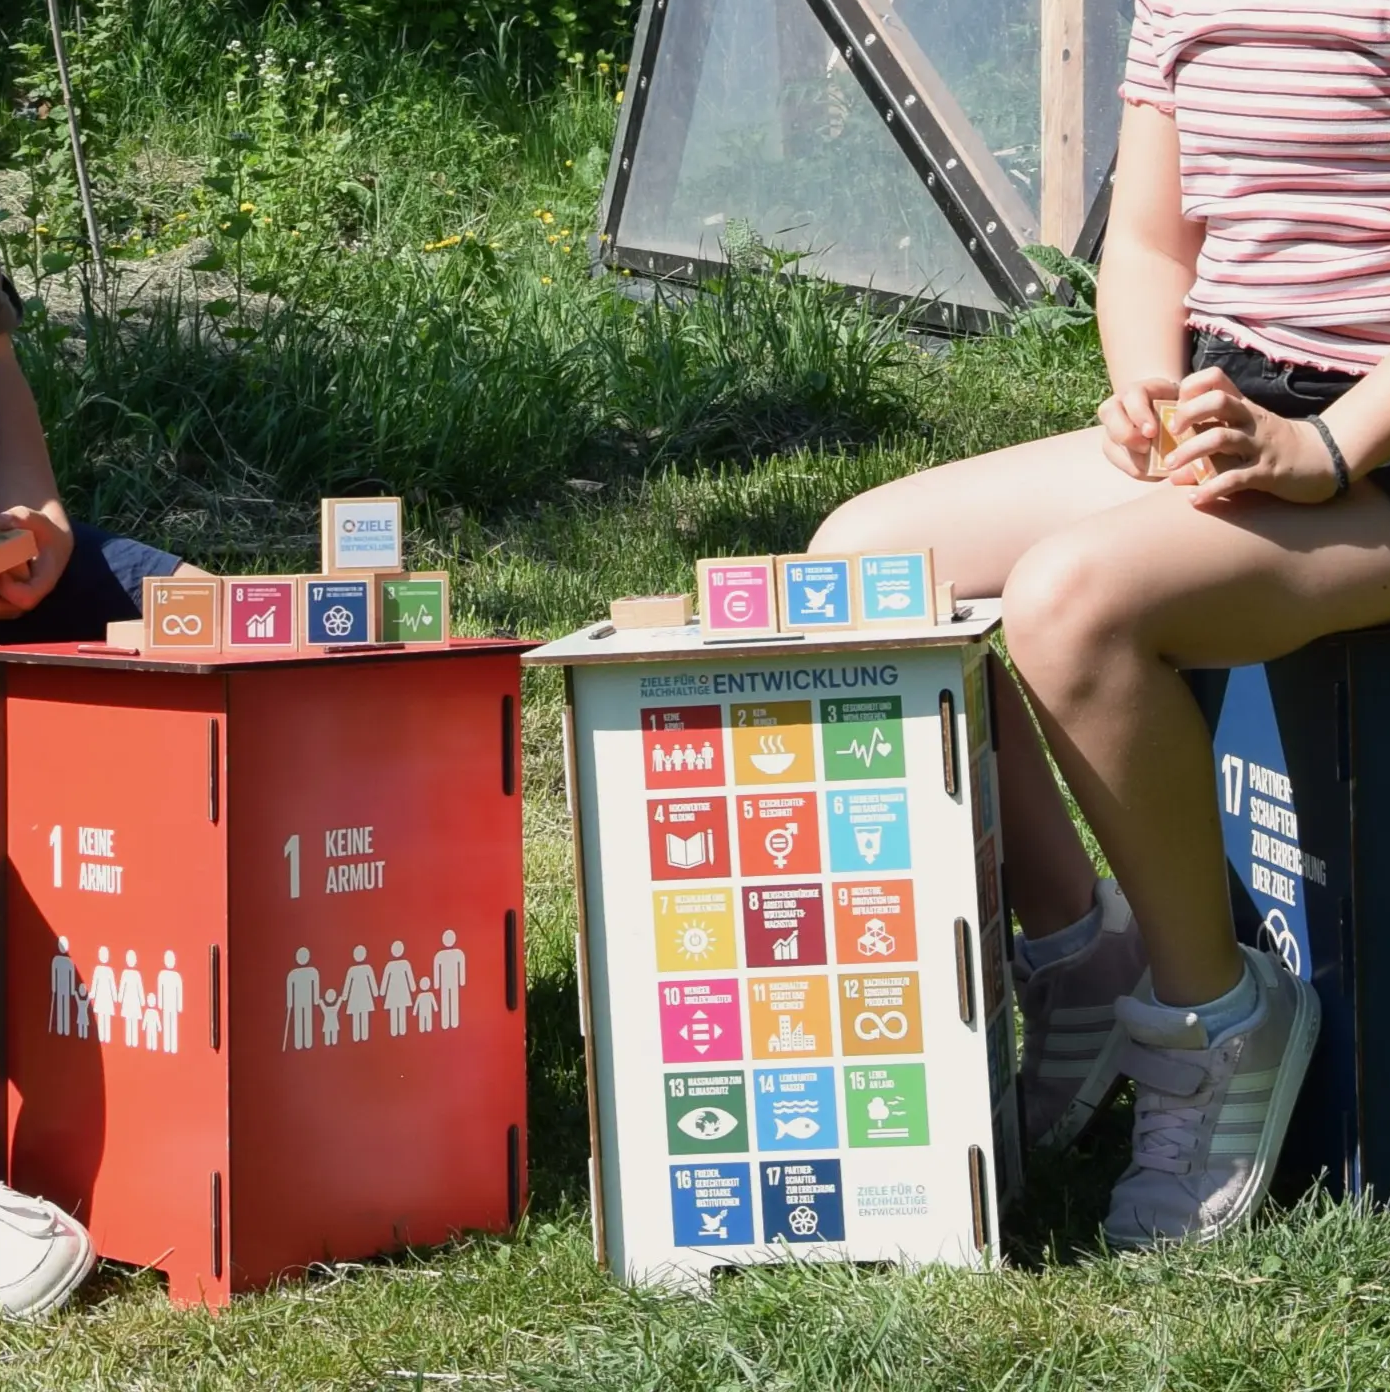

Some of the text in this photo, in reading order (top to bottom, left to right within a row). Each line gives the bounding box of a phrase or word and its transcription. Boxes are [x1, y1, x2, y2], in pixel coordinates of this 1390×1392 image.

[357, 519, 393, 533] ZIELE
[711, 572, 724, 587] 10
[790, 567, 803, 582] 16
[156, 590, 168, 605] 12
[236, 587, 244, 602] 8
[312, 586, 324, 602] 17
[387, 586, 396, 601] 3
[640, 673, 696, 688] ZIELE FÜR
[713, 664, 899, 695] ENTWICKLUNG
[640, 686, 711, 698] NACHHALTIGE
[649, 714, 658, 733] 1
[737, 709, 747, 728] 2
[827, 705, 838, 723] 3
[1221, 753, 1244, 817] 17
[1248, 761, 1294, 805] PARTNER-
[654, 804, 665, 824] 4
[742, 800, 754, 820] 5
[833, 796, 845, 815] 6
[1249, 795, 1299, 841] SCHAFTEN
[78, 826, 115, 858] KEINE
[325, 826, 374, 858] KEINE
[49, 825, 62, 889] 1
[284, 834, 300, 900] 1
[1251, 828, 1327, 888] ZUR ERREICHUNG
[78, 862, 124, 895] ARMUT
[325, 860, 386, 895] ARMUT
[1252, 862, 1296, 907] DER ZIELE
[659, 895, 670, 915] 7
[748, 891, 760, 911] 8
[838, 887, 850, 907] 9
[663, 986, 680, 1007] 10
[752, 982, 766, 1003] 11
[843, 979, 860, 999] 12
[668, 1077, 685, 1098] 13
[757, 1074, 776, 1095] 14
[848, 1070, 866, 1091] 15
[675, 1169, 693, 1190] 16
[765, 1166, 782, 1187] 17
[856, 1182, 913, 1197] ZIELE FÜR
[857, 1194, 928, 1207] NACHHALTIGE
[858, 1206, 929, 1217] ENTWICKLUNG
